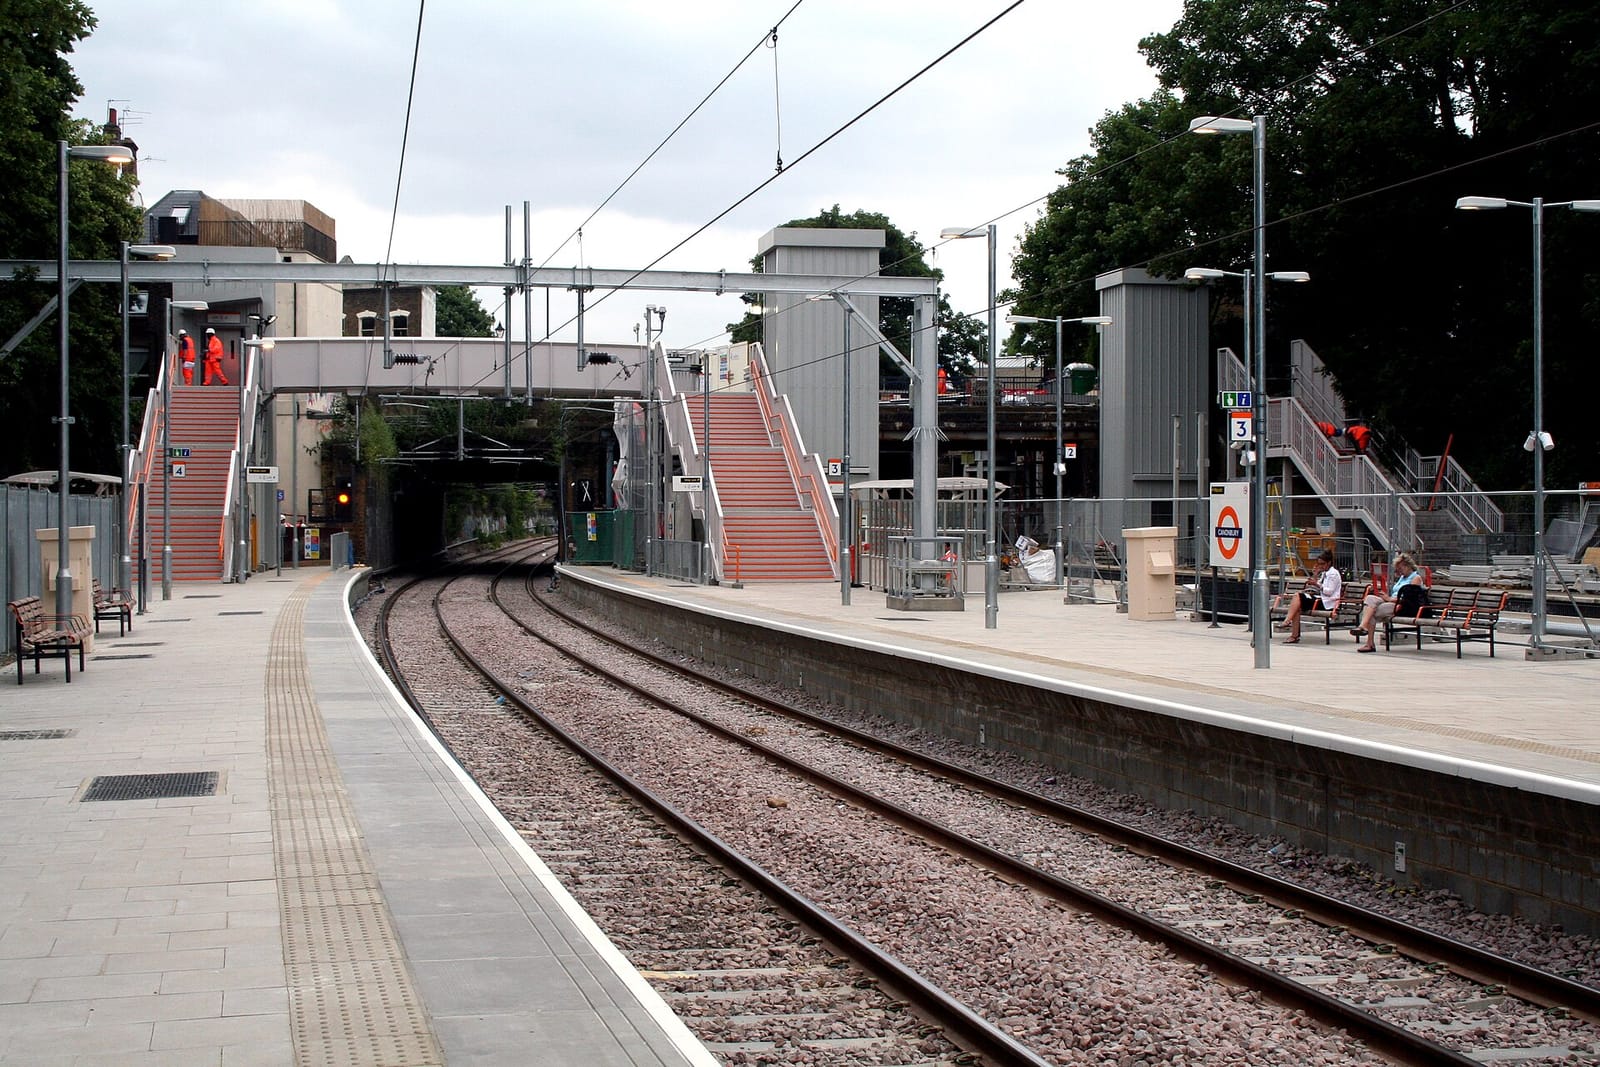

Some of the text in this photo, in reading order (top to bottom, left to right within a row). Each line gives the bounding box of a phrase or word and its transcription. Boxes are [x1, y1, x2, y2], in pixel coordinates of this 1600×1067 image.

[1236, 421, 1247, 437] 3
[1068, 448, 1074, 456] 2
[175, 467, 183, 475] 4
[831, 464, 838, 473] 3
[1217, 528, 1240, 537] CANONBURY
